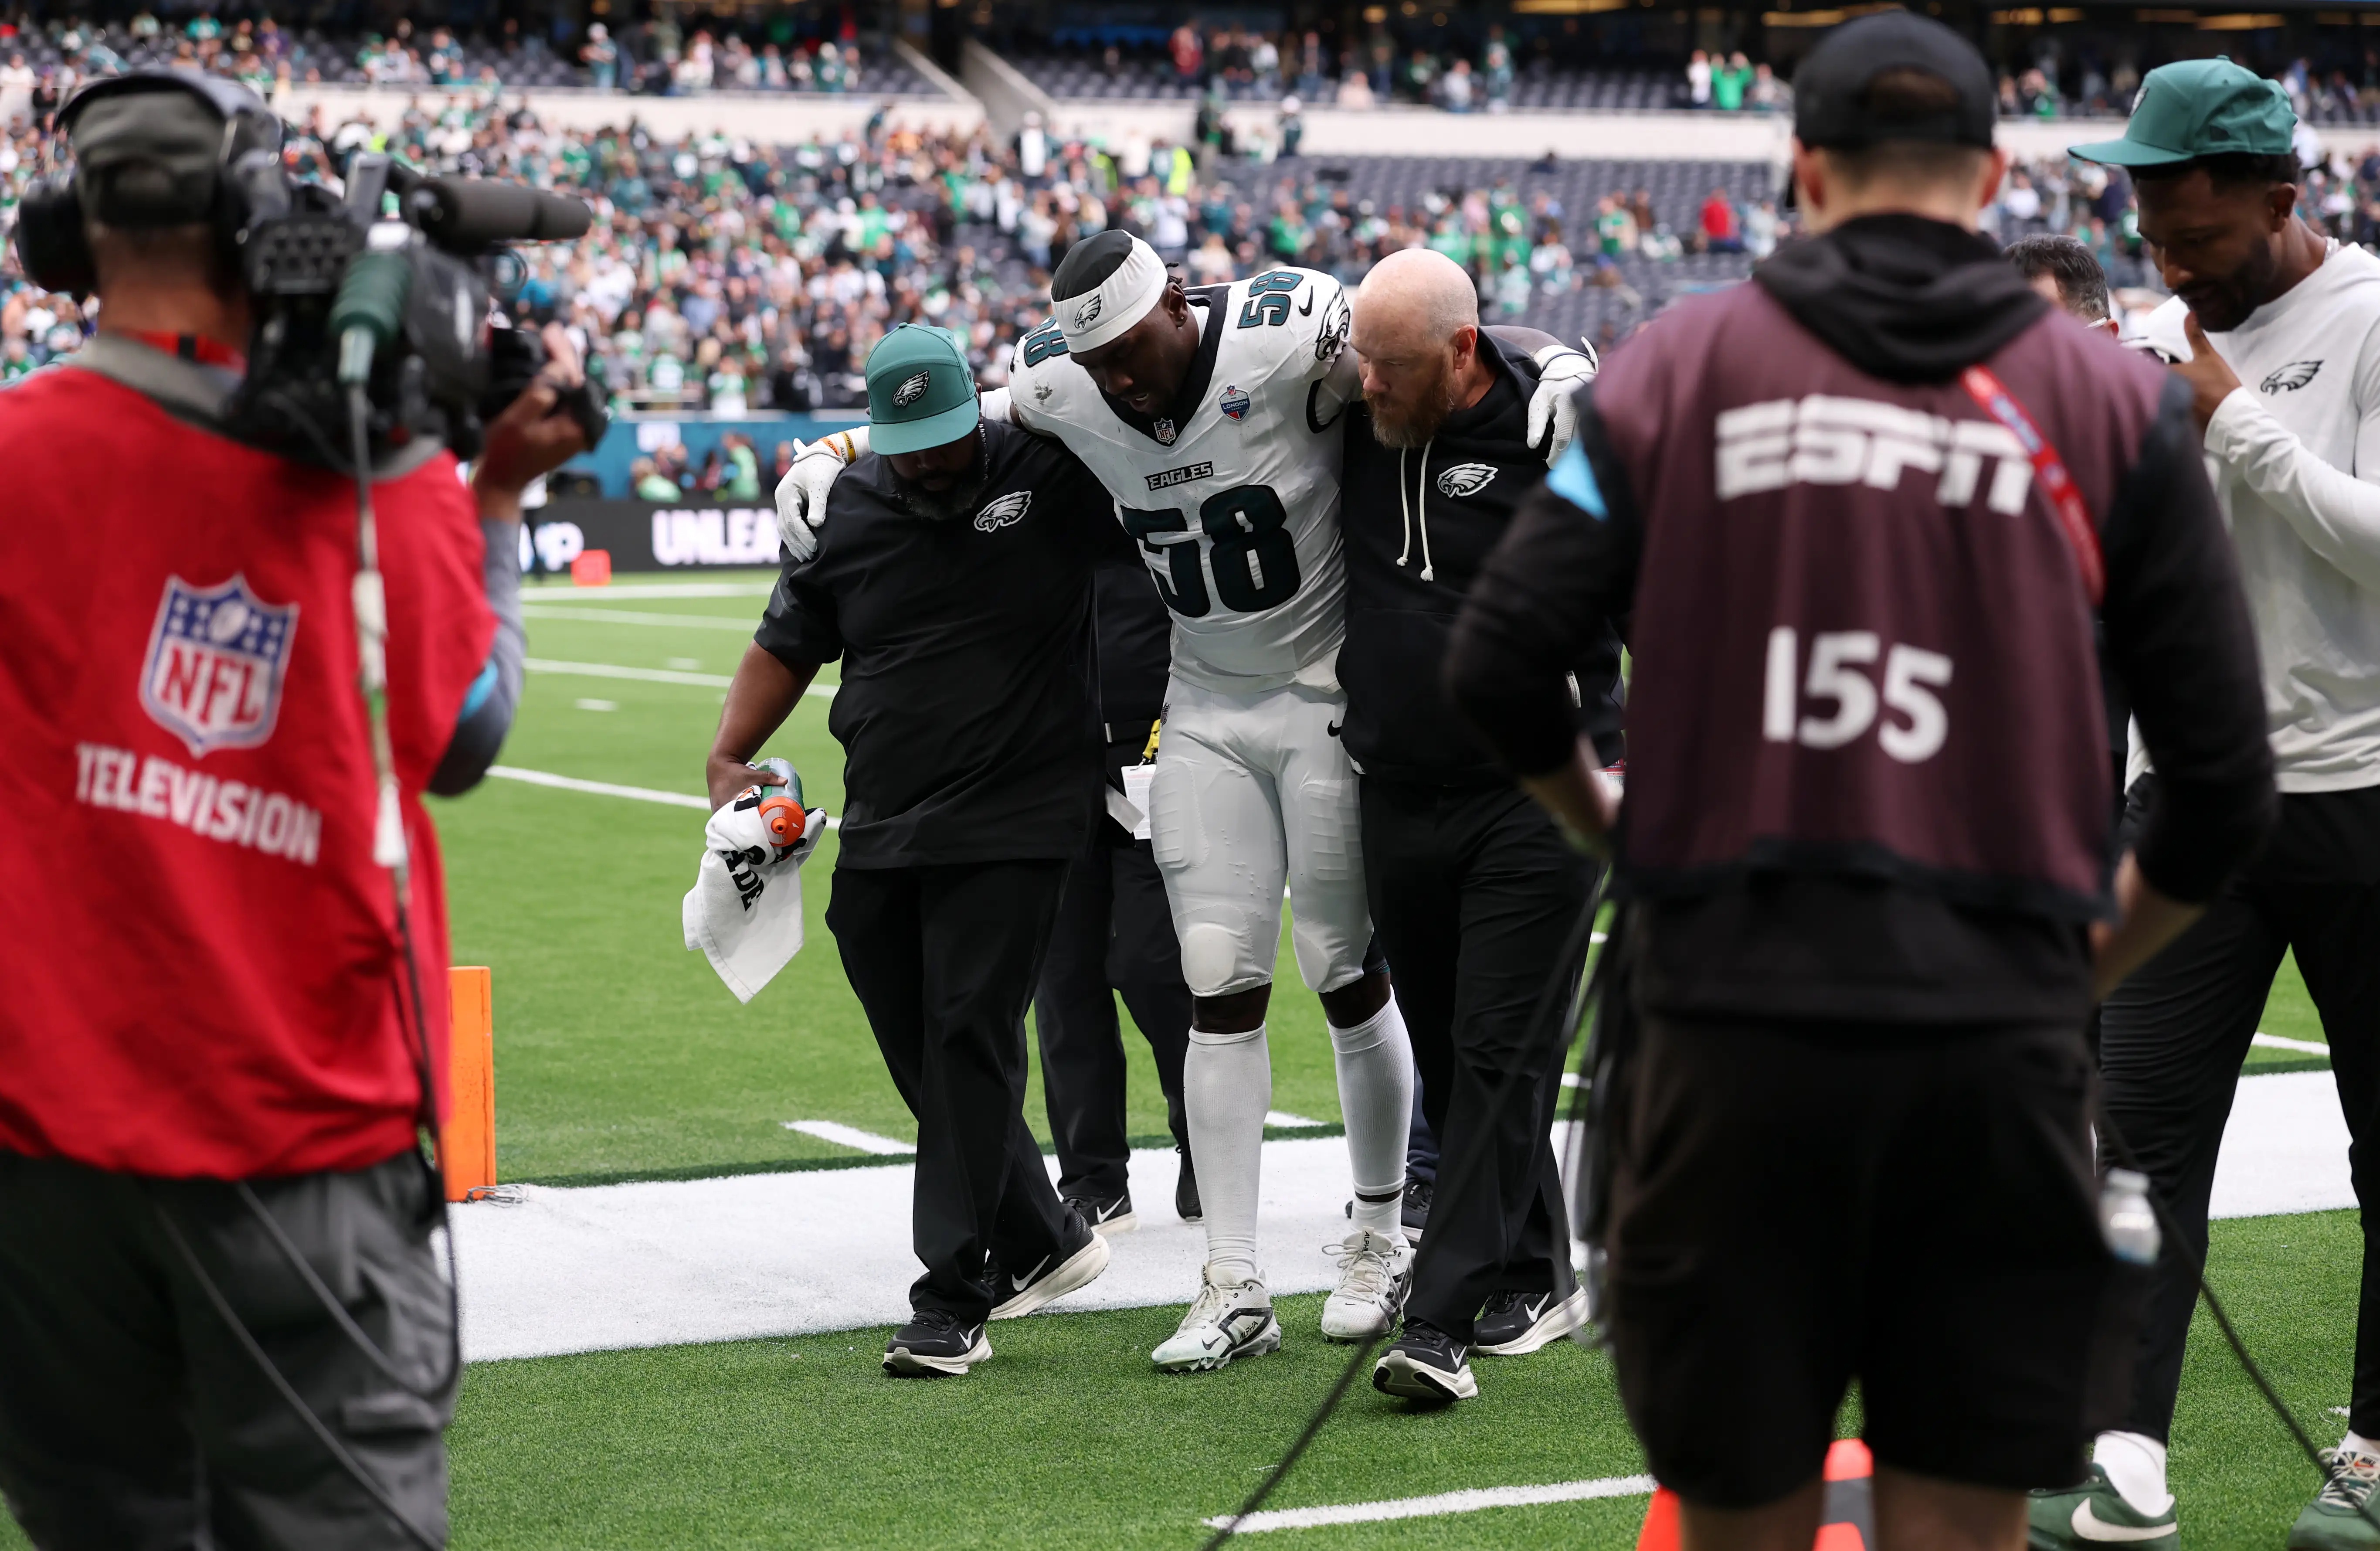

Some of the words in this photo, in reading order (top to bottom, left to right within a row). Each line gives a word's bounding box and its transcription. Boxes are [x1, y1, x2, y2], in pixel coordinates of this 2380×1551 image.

[1237, 271, 1304, 329] 58
[1159, 429, 1173, 439] NFL
[1222, 400, 1248, 409] LONDON
[1148, 463, 1212, 490] EAGLES
[1716, 393, 2034, 516] ESPN
[1120, 484, 1301, 618] 58
[160, 645, 267, 726] NFL
[1762, 625, 1953, 765] 155
[76, 742, 323, 865] TELEVISION
